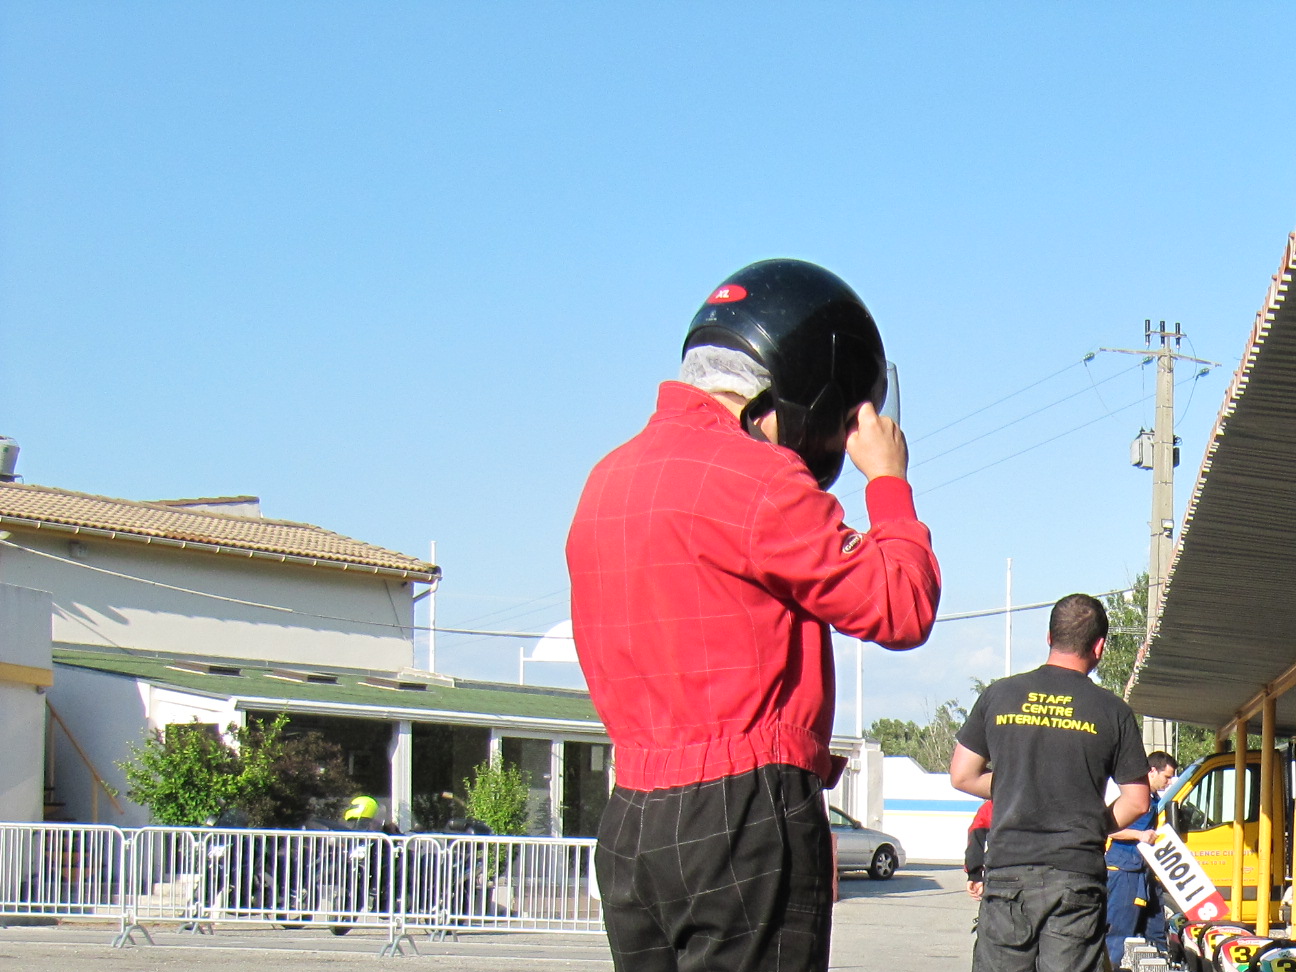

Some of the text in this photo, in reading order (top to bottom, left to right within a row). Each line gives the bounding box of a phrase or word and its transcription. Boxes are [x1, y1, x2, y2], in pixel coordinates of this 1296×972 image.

[1028, 692, 1073, 704] STAFF
[1021, 703, 1074, 717] CENTRE
[996, 713, 1098, 734] INTERNATIONAL
[1154, 840, 1196, 891] TOUR
